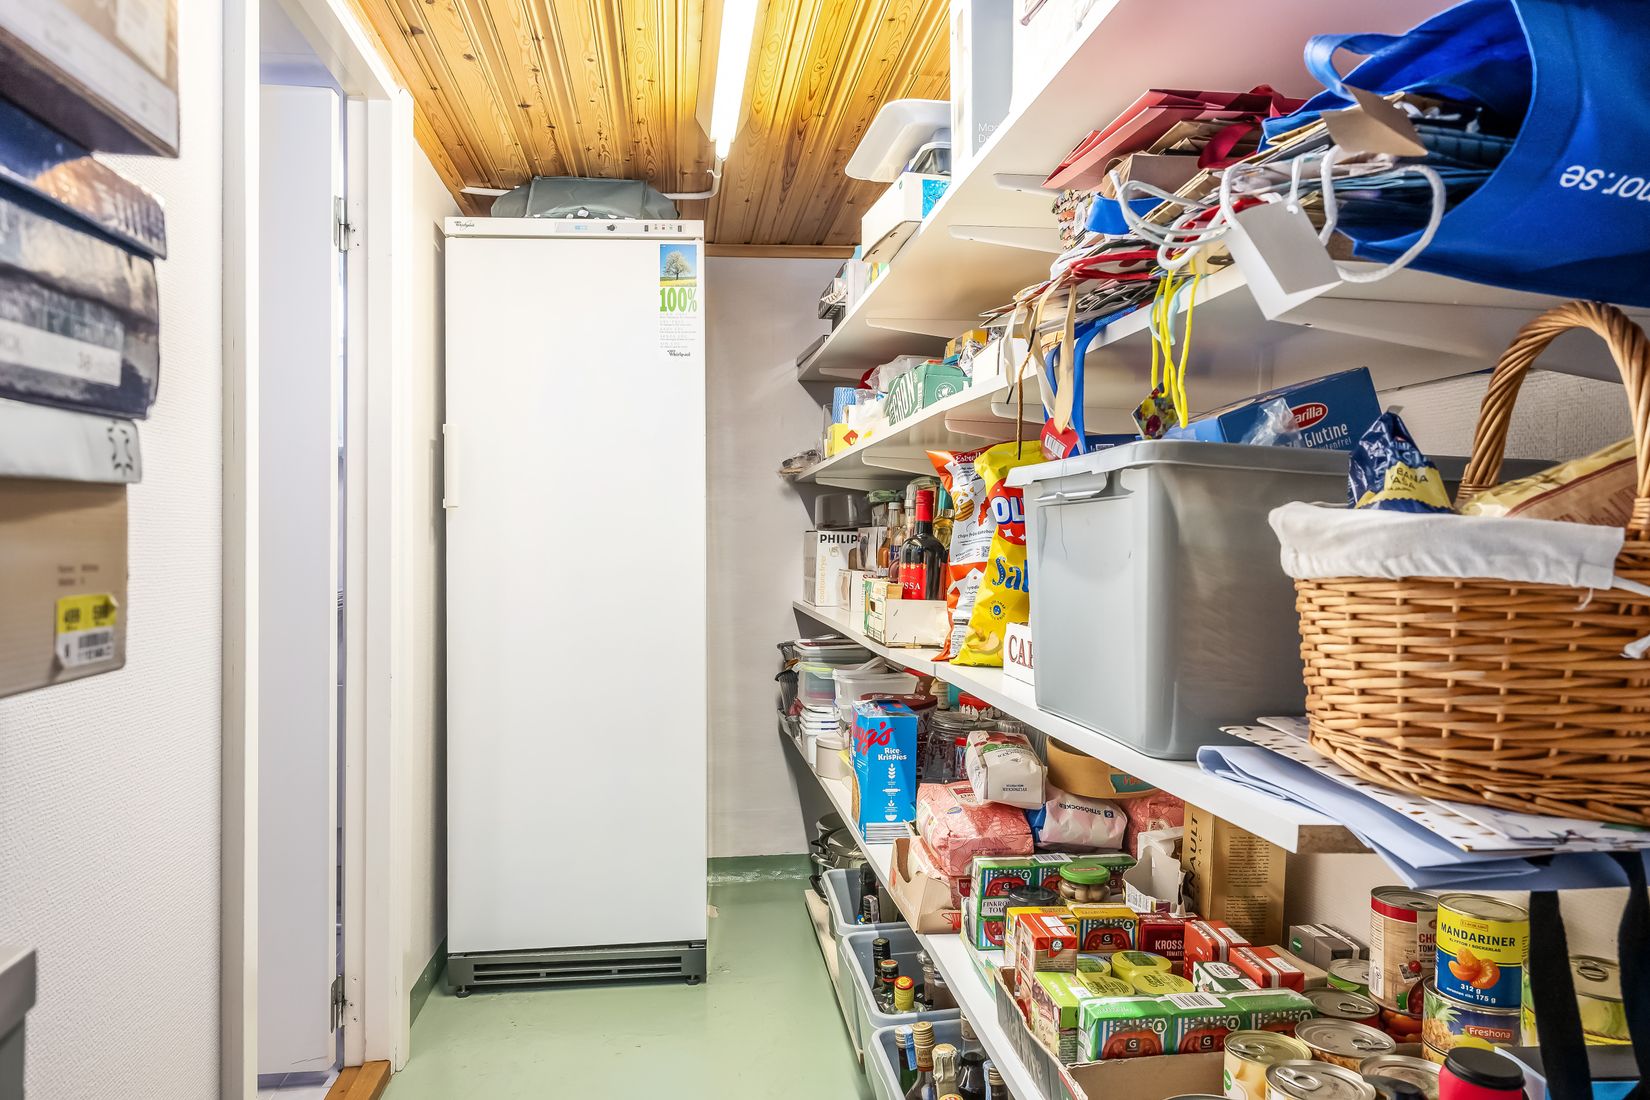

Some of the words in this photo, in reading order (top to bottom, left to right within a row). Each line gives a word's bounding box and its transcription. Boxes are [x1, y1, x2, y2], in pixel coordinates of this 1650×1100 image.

[659, 287, 698, 313] 100%
[1294, 406, 1323, 424] arilla
[1304, 423, 1349, 448] Glutine
[991, 496, 1024, 524] OL
[820, 534, 860, 544] PHILIP
[991, 556, 1029, 593] Sal
[904, 582, 921, 590] SSA
[884, 747, 900, 755] Rice
[1440, 922, 1516, 947] MANDARINER
[1155, 940, 1184, 950] KROSS
[1460, 983, 1474, 992] 312
[1475, 994, 1489, 1002] 175
[1469, 1027, 1511, 1039] Freshona
